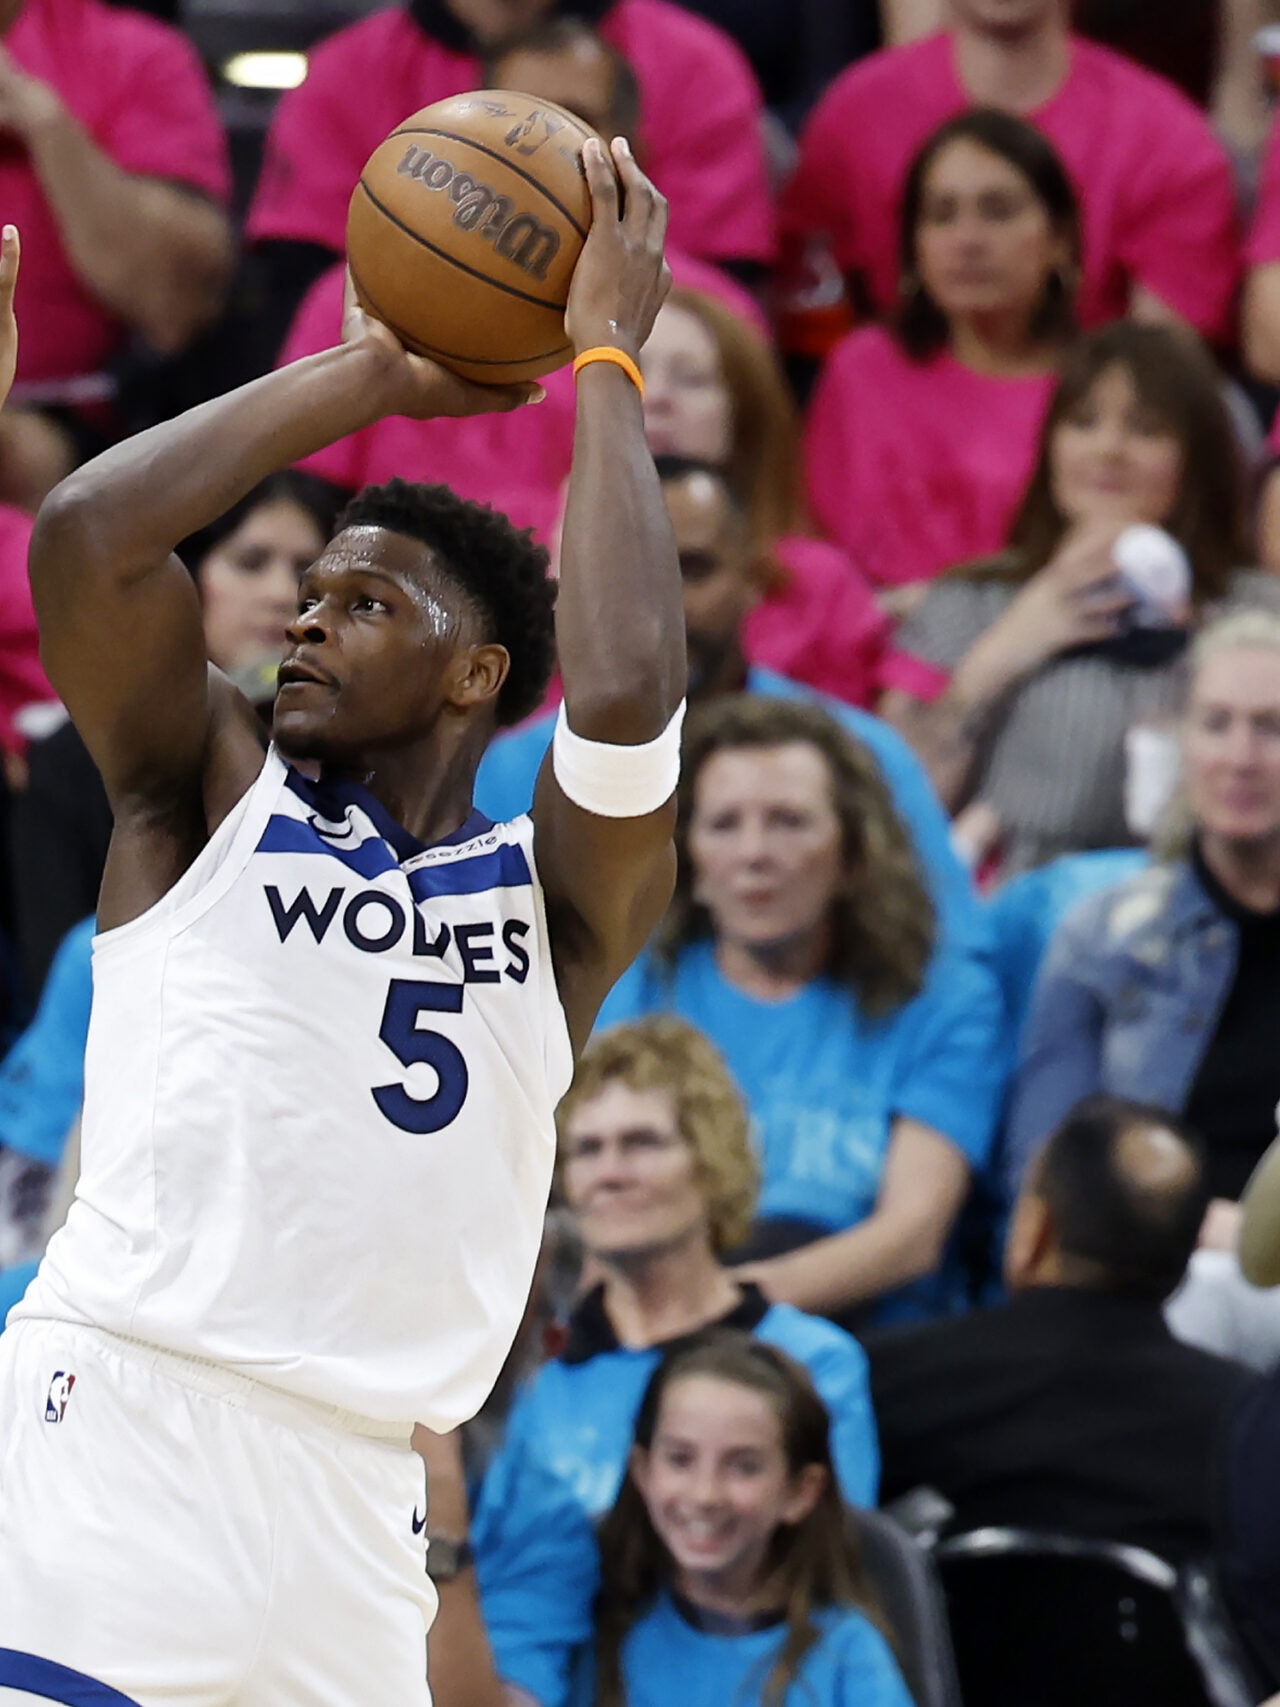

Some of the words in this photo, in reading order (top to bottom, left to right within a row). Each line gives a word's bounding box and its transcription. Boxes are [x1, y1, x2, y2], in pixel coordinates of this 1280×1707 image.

[397, 143, 561, 282] Wilson
[425, 835, 498, 860] sezzle
[370, 977, 469, 1135] 5
